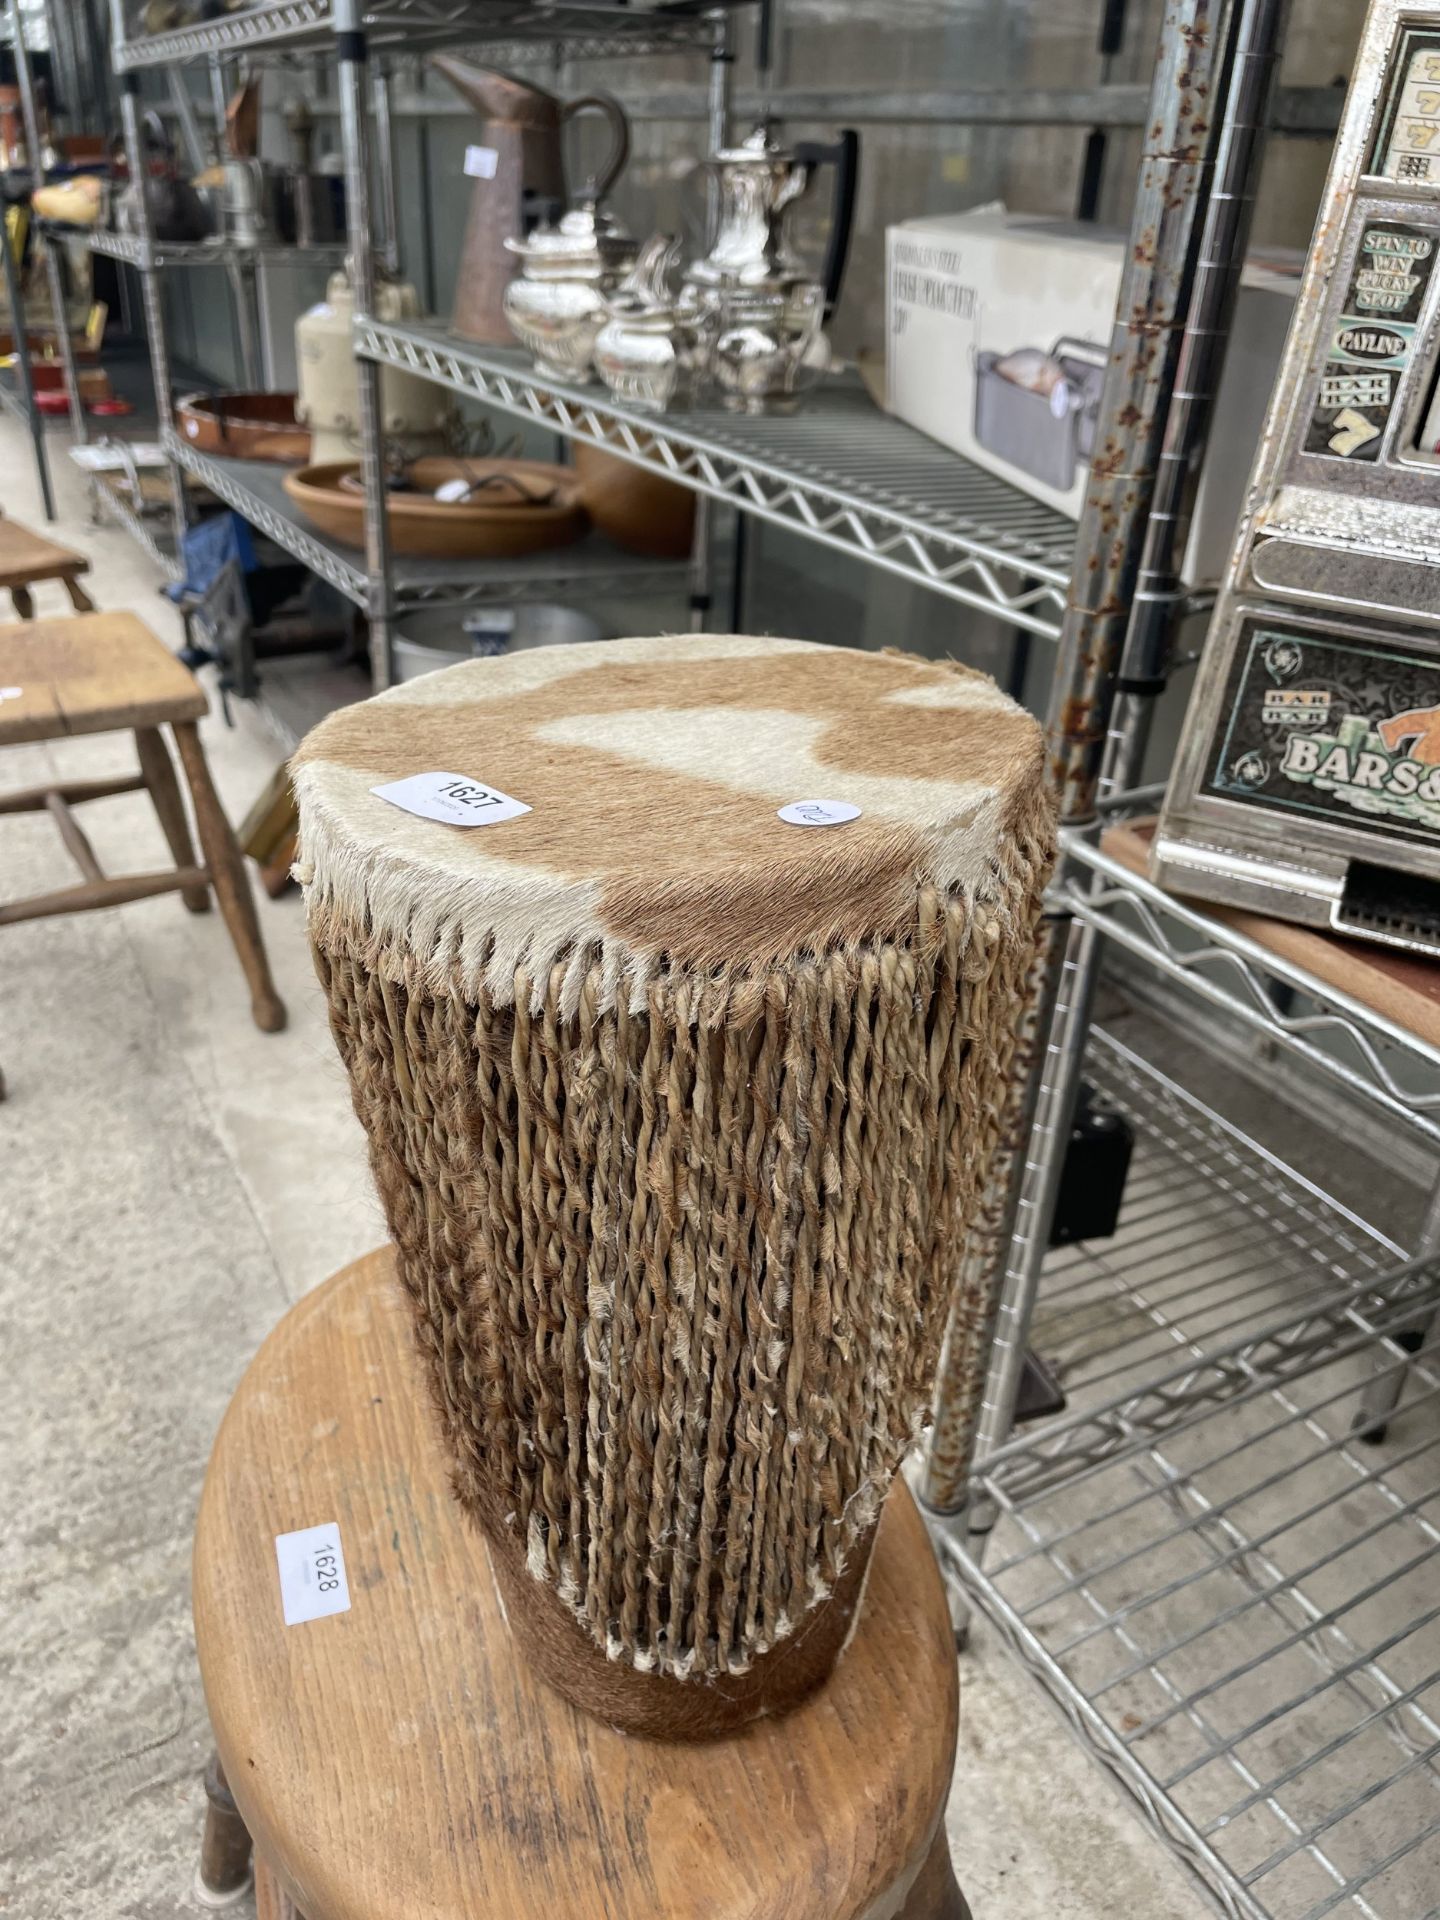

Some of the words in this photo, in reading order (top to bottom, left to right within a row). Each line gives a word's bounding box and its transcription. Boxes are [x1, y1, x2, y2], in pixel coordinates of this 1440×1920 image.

[1365, 233, 1403, 252] SPIN
[1405, 237, 1431, 257] TO
[1376, 254, 1409, 271] WIN
[1361, 291, 1406, 309] SLOT
[1340, 331, 1404, 356] PAYLINE
[1326, 378, 1384, 391] BAR
[1325, 392, 1383, 404] BAR
[1270, 693, 1326, 705] BAR
[1267, 712, 1322, 723] BAR
[438, 780, 505, 809] 1627
[315, 1544, 339, 1592] 1628
